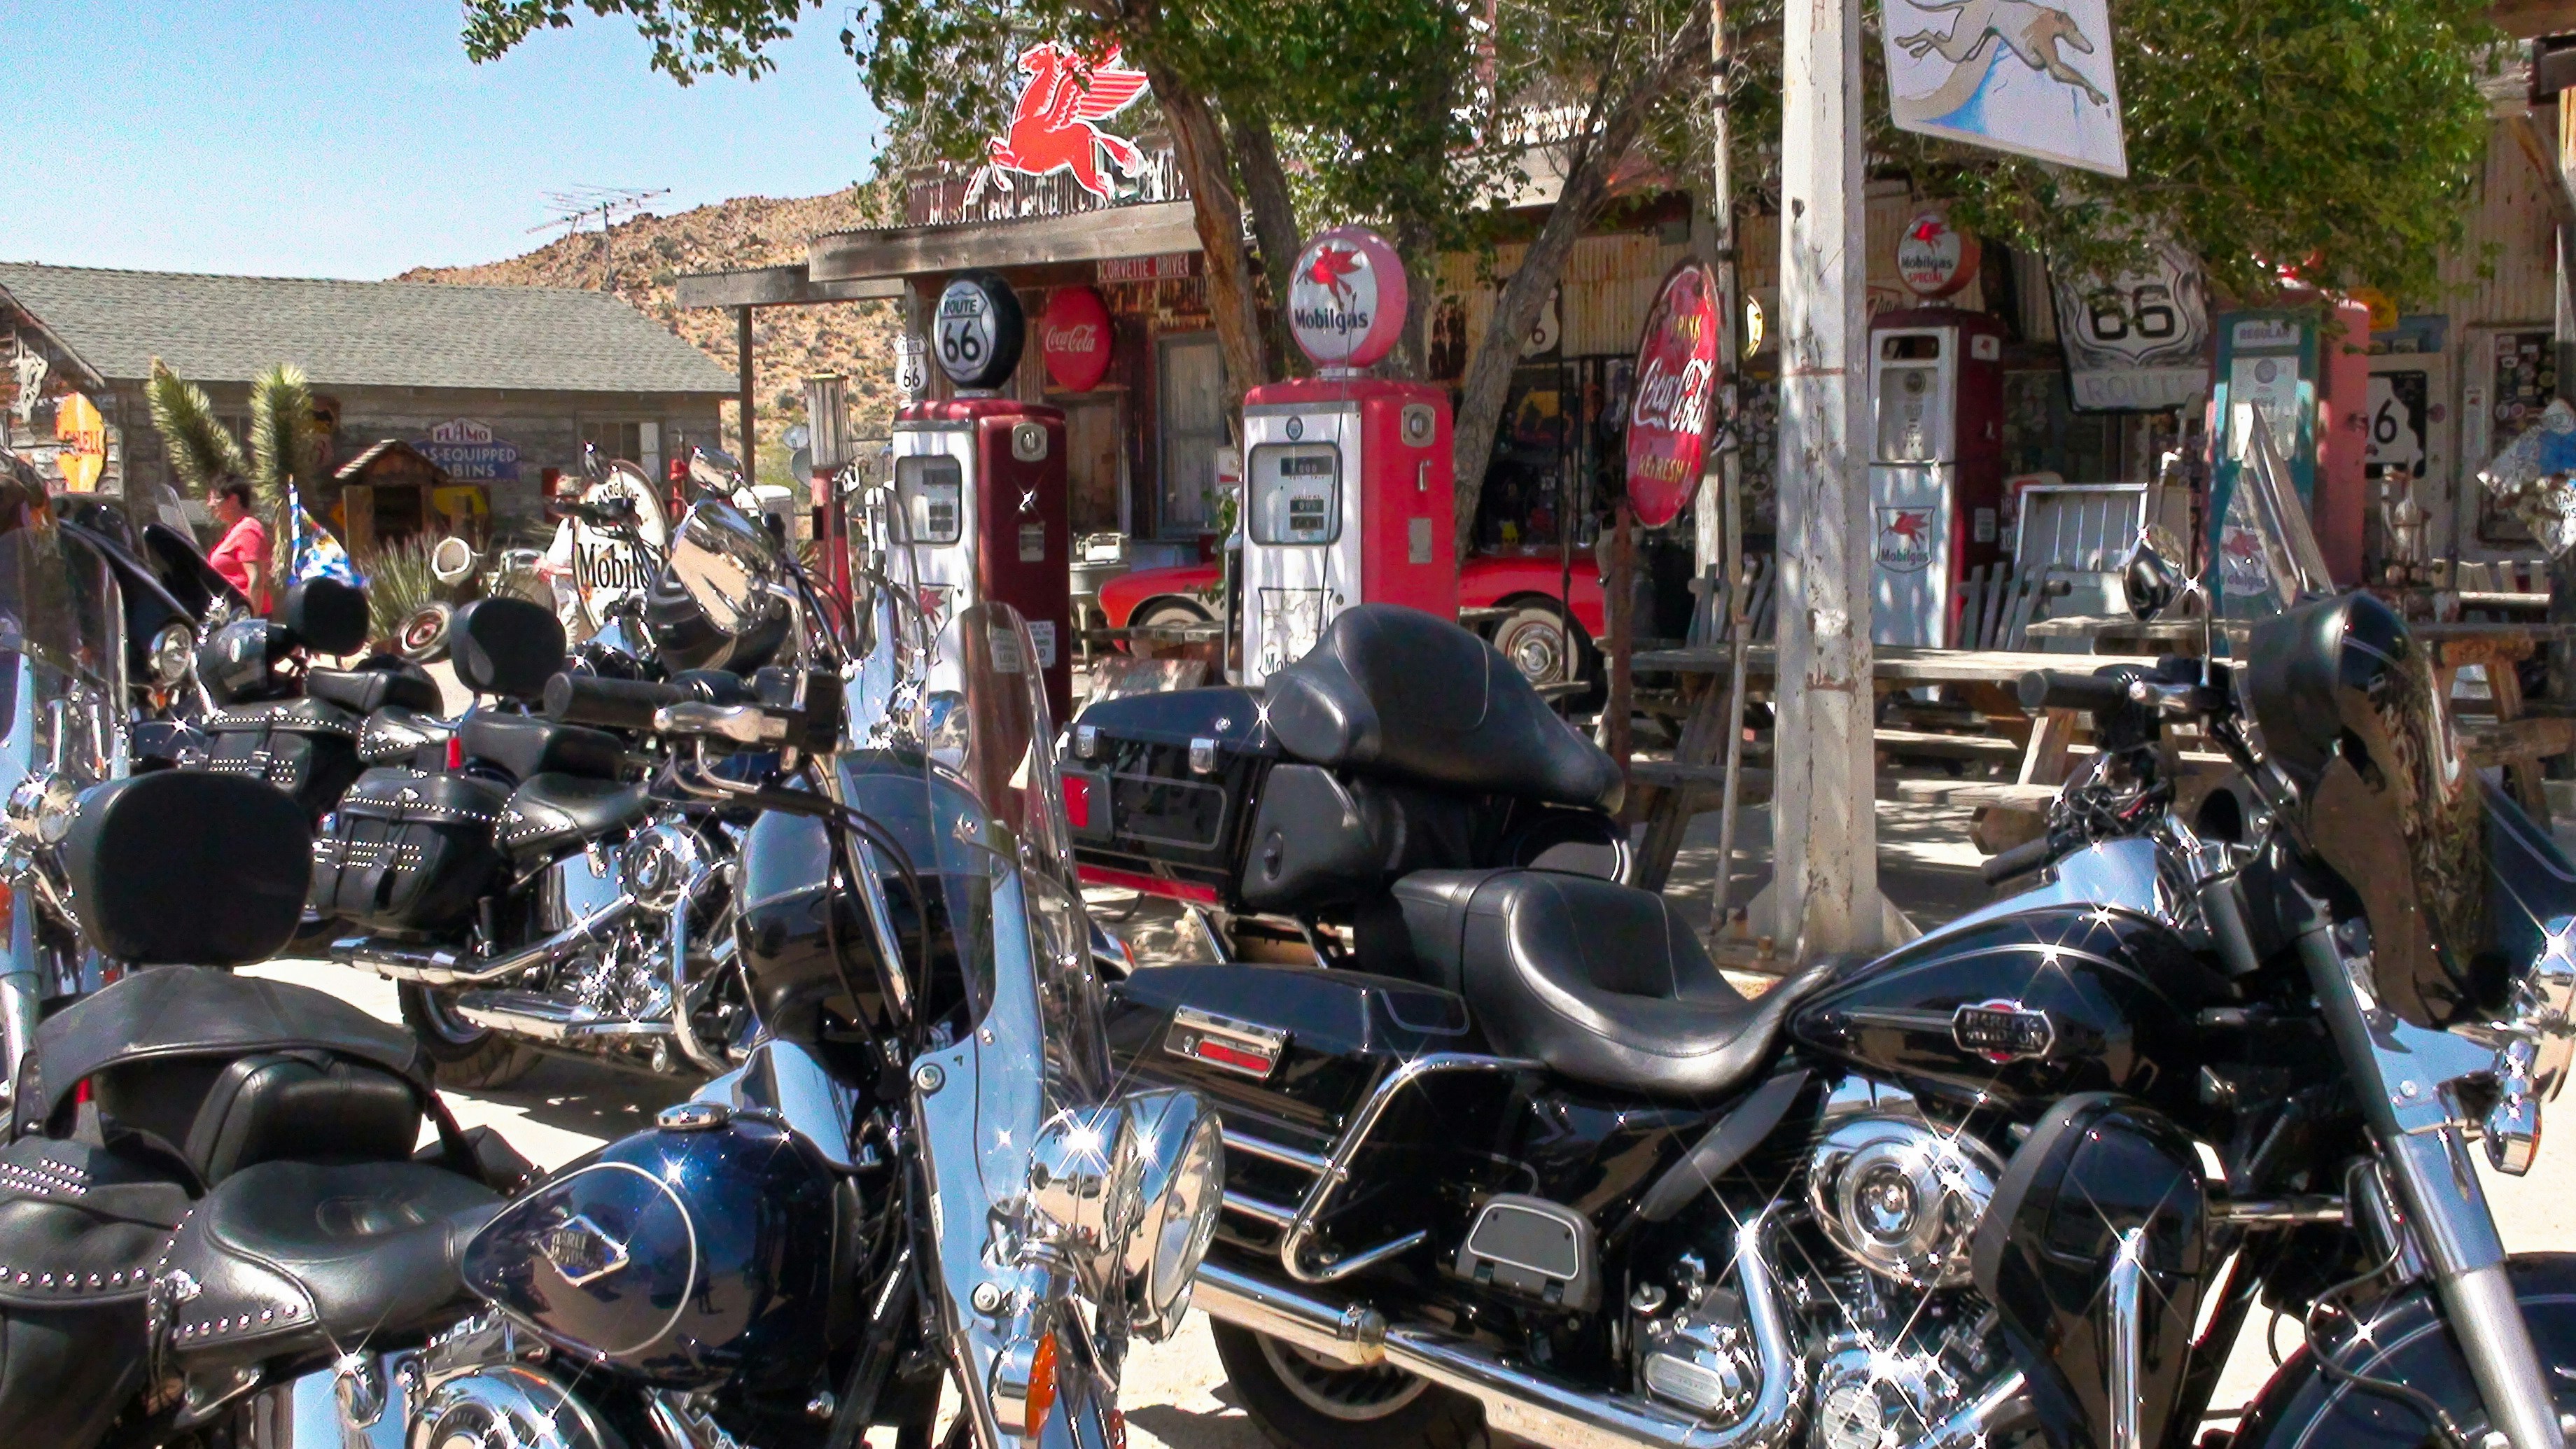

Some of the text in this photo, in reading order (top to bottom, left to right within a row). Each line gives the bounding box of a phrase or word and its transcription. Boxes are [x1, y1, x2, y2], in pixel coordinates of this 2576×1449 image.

[1102, 253, 1185, 280] CORVETTE DRIVE
[1900, 255, 1953, 273] Mobilgas
[945, 299, 977, 314] ROUTE
[2089, 284, 2175, 340] 66
[1294, 307, 1368, 335] Mobilgas
[1672, 314, 1702, 340] DRINK
[944, 320, 980, 363] 66
[903, 367, 920, 388] 66
[436, 421, 489, 442] FLAMO
[1881, 548, 1929, 566] Mobilgas
